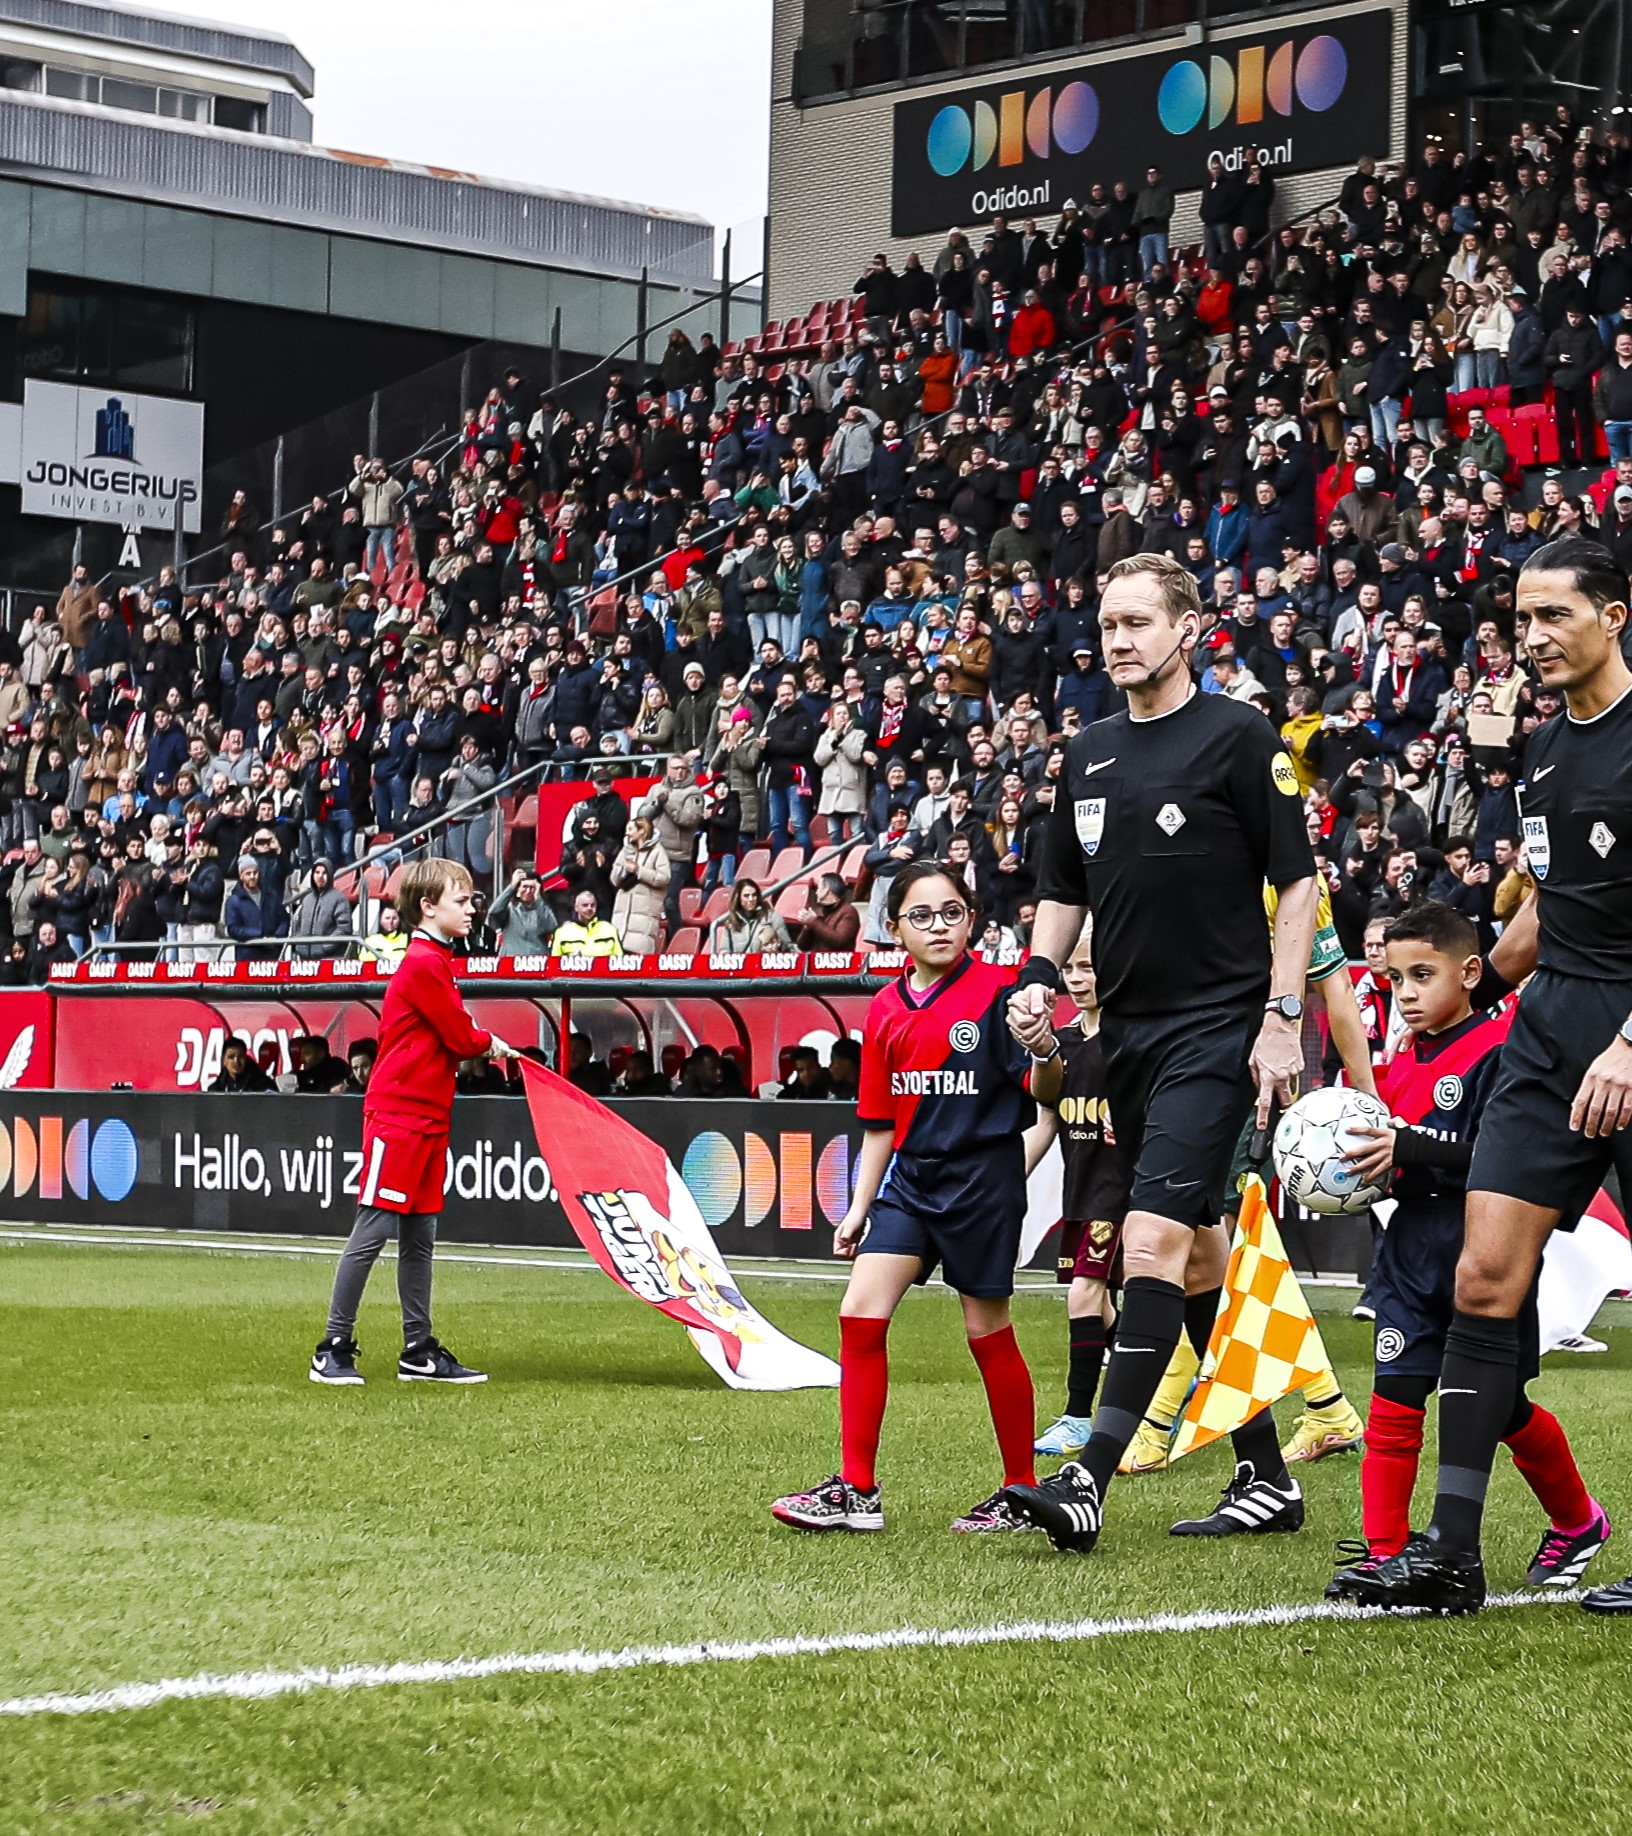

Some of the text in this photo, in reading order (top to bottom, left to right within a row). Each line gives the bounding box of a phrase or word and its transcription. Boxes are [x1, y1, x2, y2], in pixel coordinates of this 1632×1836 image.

[1207, 138, 1292, 172] Odio.nl
[971, 182, 1050, 214] Odido.nl
[27, 461, 198, 503] JONGERIUS
[51, 492, 122, 516] INVEST
[118, 534, 141, 568] A
[1078, 801, 1101, 818] FIFA
[1525, 821, 1545, 837] FIFA
[467, 956, 500, 973] DASSY
[514, 955, 547, 972] DASSY
[560, 954, 594, 971] DASSY
[609, 954, 644, 971] DASSY
[658, 953, 694, 971] DASSY
[709, 953, 746, 971] DASSY
[761, 952, 799, 970] DASSY
[814, 951, 853, 969] DASSY
[868, 951, 908, 968] DASSY
[981, 948, 1023, 966] DSSY
[51, 962, 78, 979] DASSY
[89, 962, 117, 979] DASSY
[128, 962, 156, 978] DASSY
[168, 962, 197, 978] DASSY
[207, 961, 237, 978] DASSY
[249, 961, 279, 977] DASSY
[290, 960, 320, 977] DASSY
[333, 960, 363, 976] DASSY
[174, 1132, 271, 1197] Hallo,
[280, 1134, 334, 1209] wij
